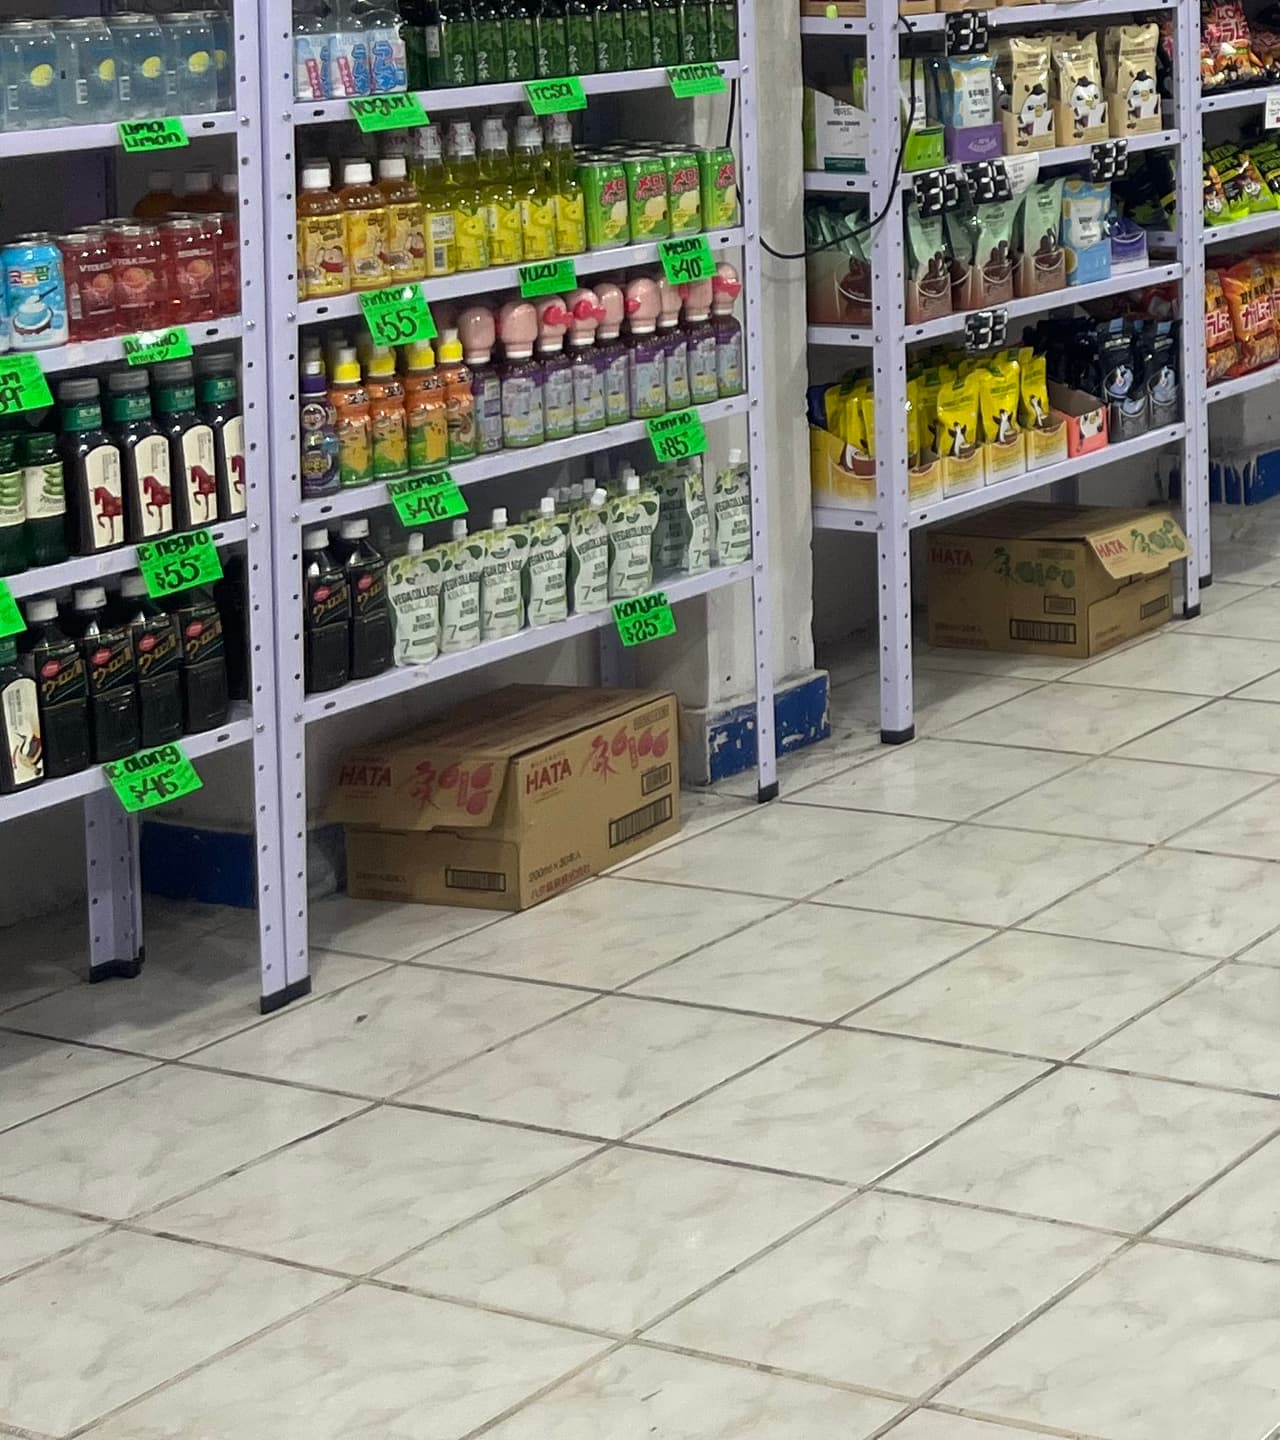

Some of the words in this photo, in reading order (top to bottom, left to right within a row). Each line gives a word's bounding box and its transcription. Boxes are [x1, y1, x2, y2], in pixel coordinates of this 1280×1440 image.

[375, 306, 418, 343] $55
[1095, 538, 1129, 558] HATA
[154, 556, 204, 591] $55
[525, 757, 573, 795] HATA
